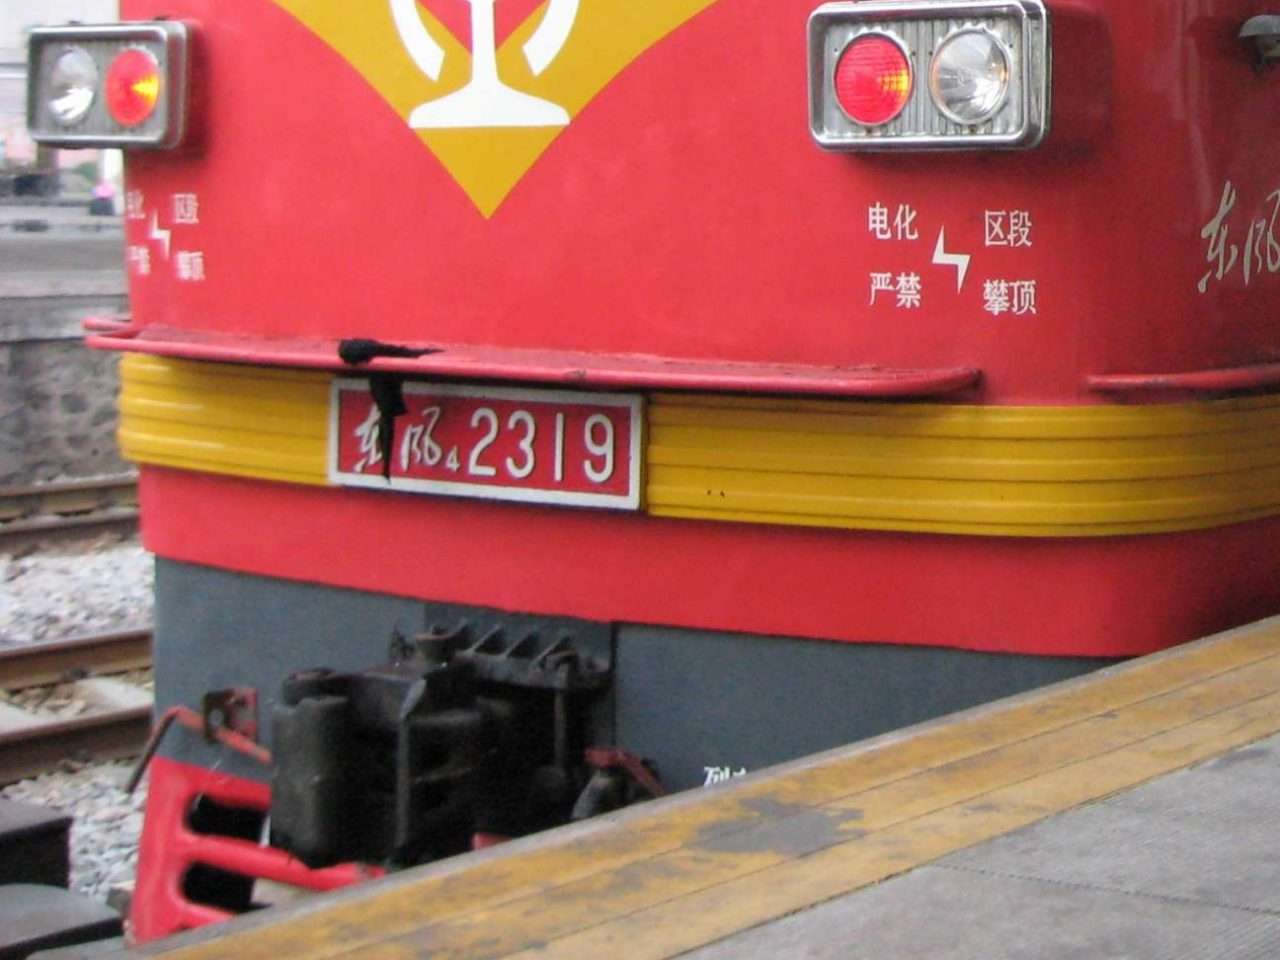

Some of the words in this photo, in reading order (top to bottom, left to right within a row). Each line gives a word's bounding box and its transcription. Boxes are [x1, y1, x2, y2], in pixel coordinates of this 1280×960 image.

[867, 201, 919, 241] 电化
[984, 209, 1032, 248] 区段
[869, 271, 922, 309] 严禁
[983, 279, 1037, 316] 攀顶
[467, 406, 615, 483] 2319
